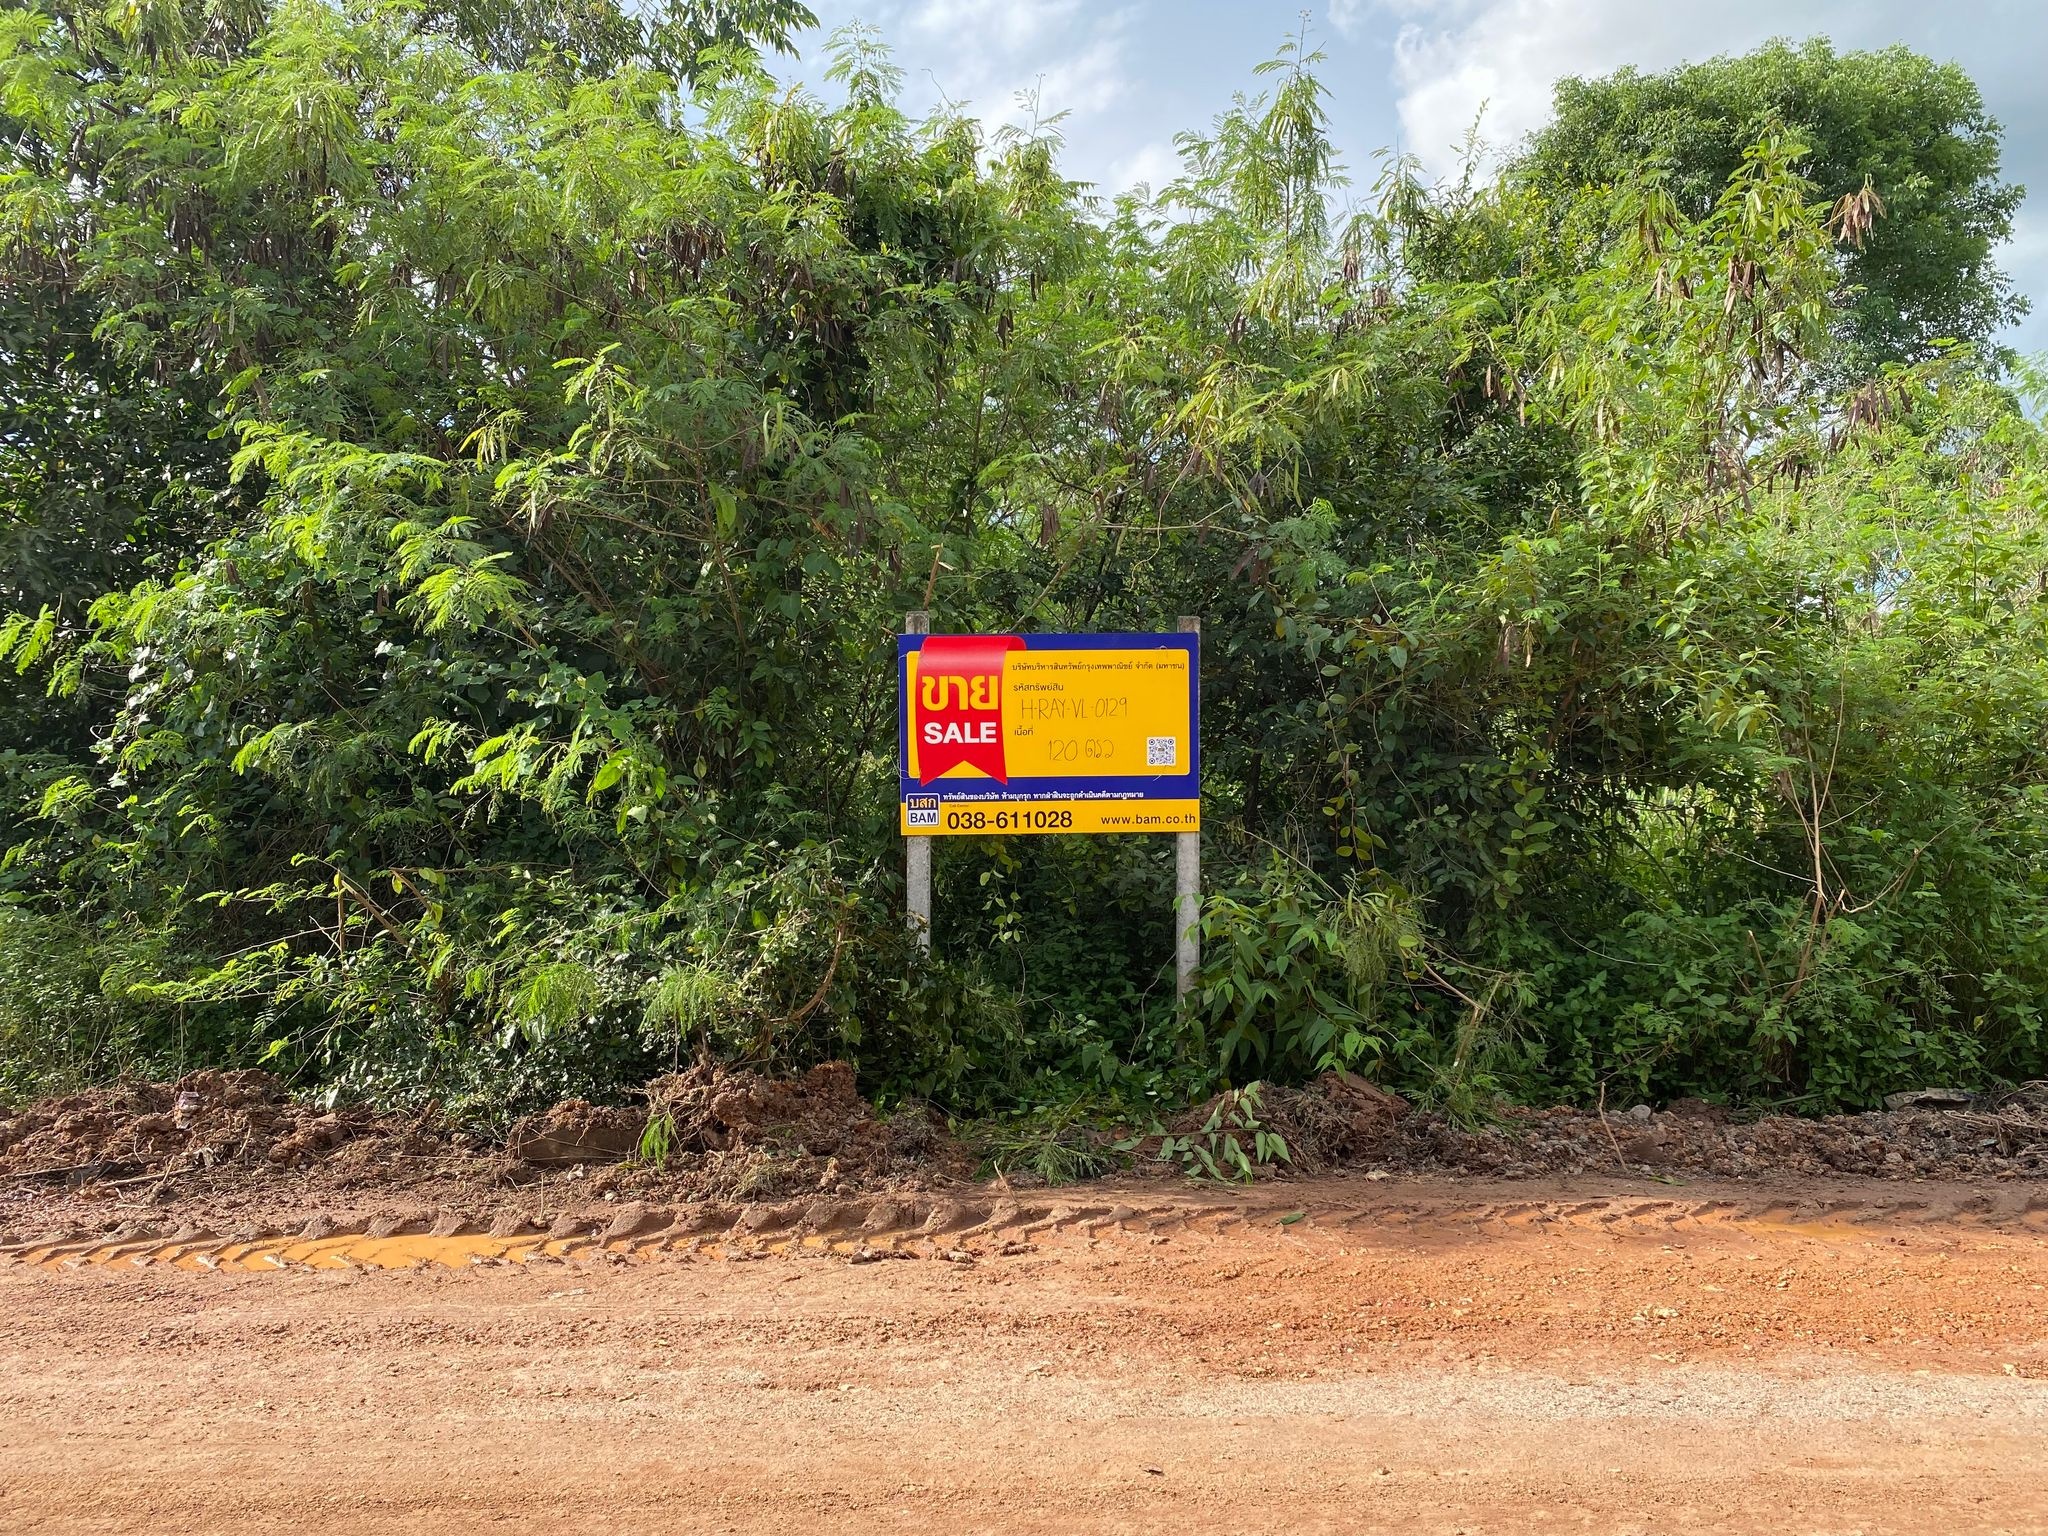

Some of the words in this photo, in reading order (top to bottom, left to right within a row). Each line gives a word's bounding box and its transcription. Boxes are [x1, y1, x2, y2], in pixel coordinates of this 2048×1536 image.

[1135, 661, 1153, 670] จำกัด
[1155, 662, 1185, 670] (มหาชน)
[1013, 682, 1064, 691] รหัสทรัพย์สิน
[921, 675, 999, 711] ขาย
[924, 721, 997, 744] SALE
[1014, 724, 1034, 736] เนื้อที่
[1048, 739, 1078, 761] 120
[1001, 791, 1032, 802] ห้ามบุกรุก
[909, 797, 937, 809] บสก
[910, 812, 937, 824] BAM
[947, 810, 1073, 830] 038-611028
[1101, 813, 1196, 825] www.bam.co.th
